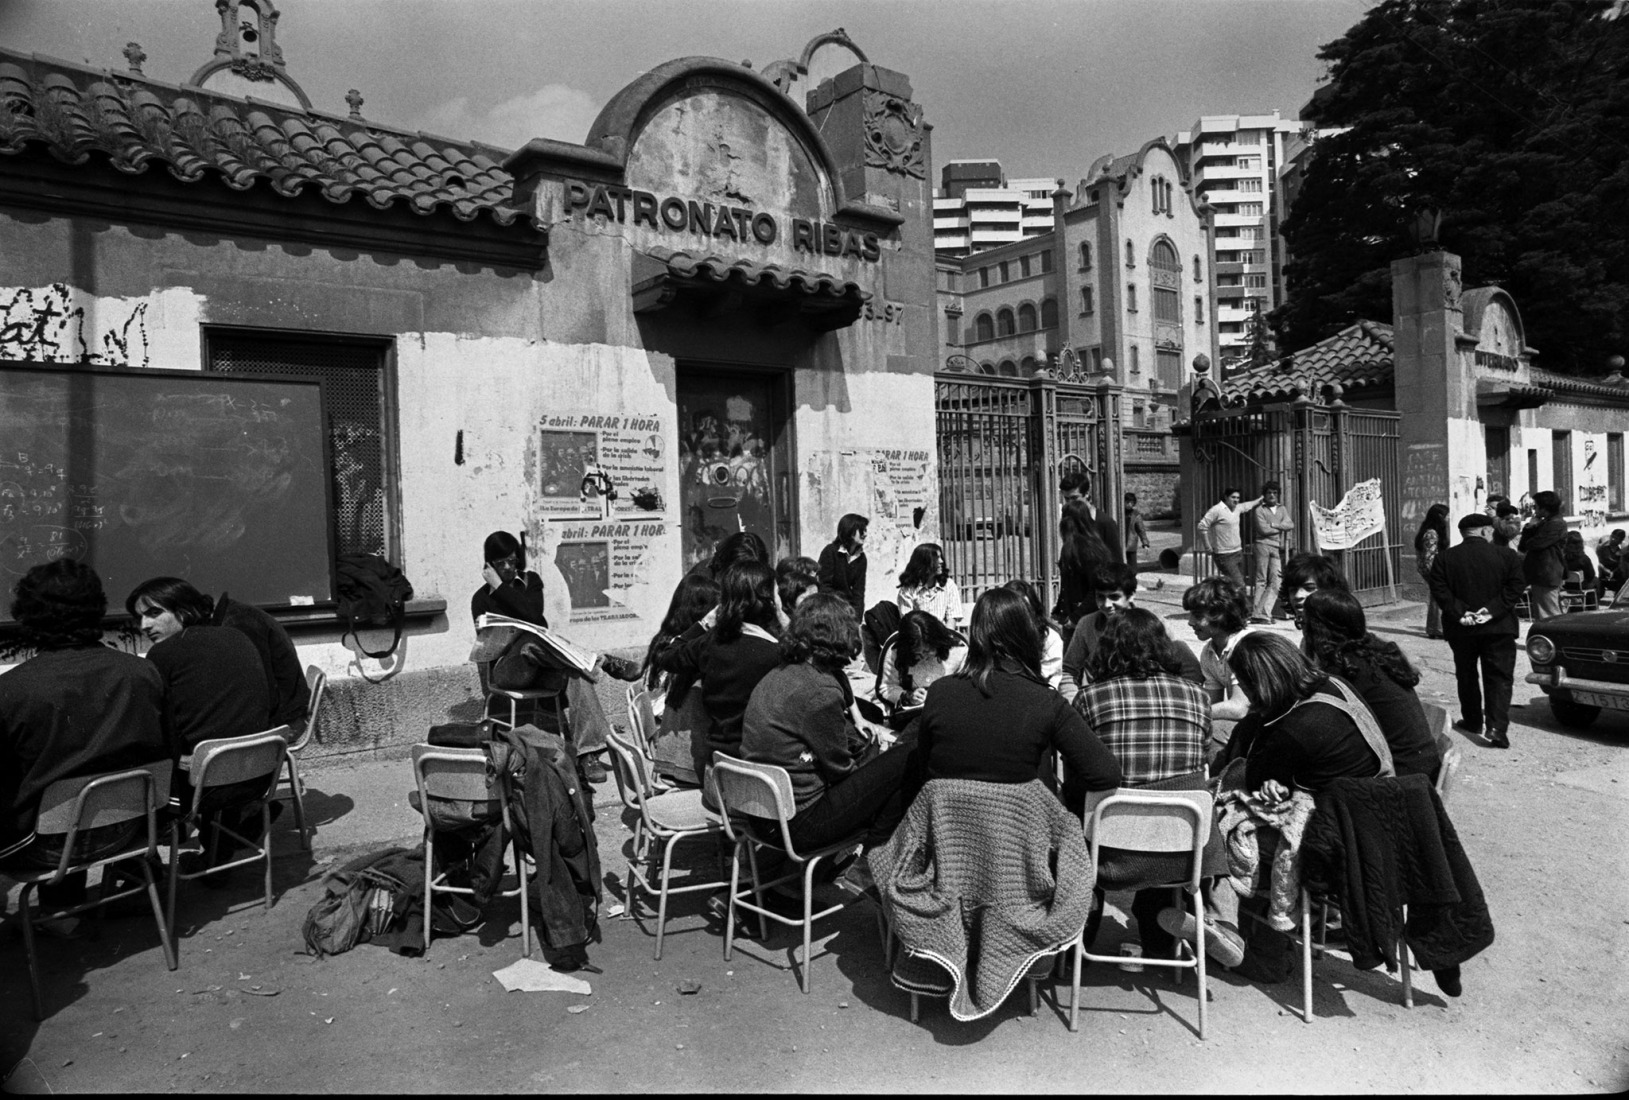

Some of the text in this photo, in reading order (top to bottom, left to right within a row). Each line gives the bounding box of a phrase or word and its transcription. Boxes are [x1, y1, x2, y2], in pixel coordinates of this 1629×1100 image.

[563, 179, 881, 262] PATRONATO RIBAS
[539, 414, 660, 433] 5 abril: PARAR 1 HORA
[903, 450, 908, 460] 1
[908, 450, 929, 462] HORA
[591, 524, 630, 538] PARAR
[633, 525, 639, 537] 1
[640, 524, 666, 537] HOR
